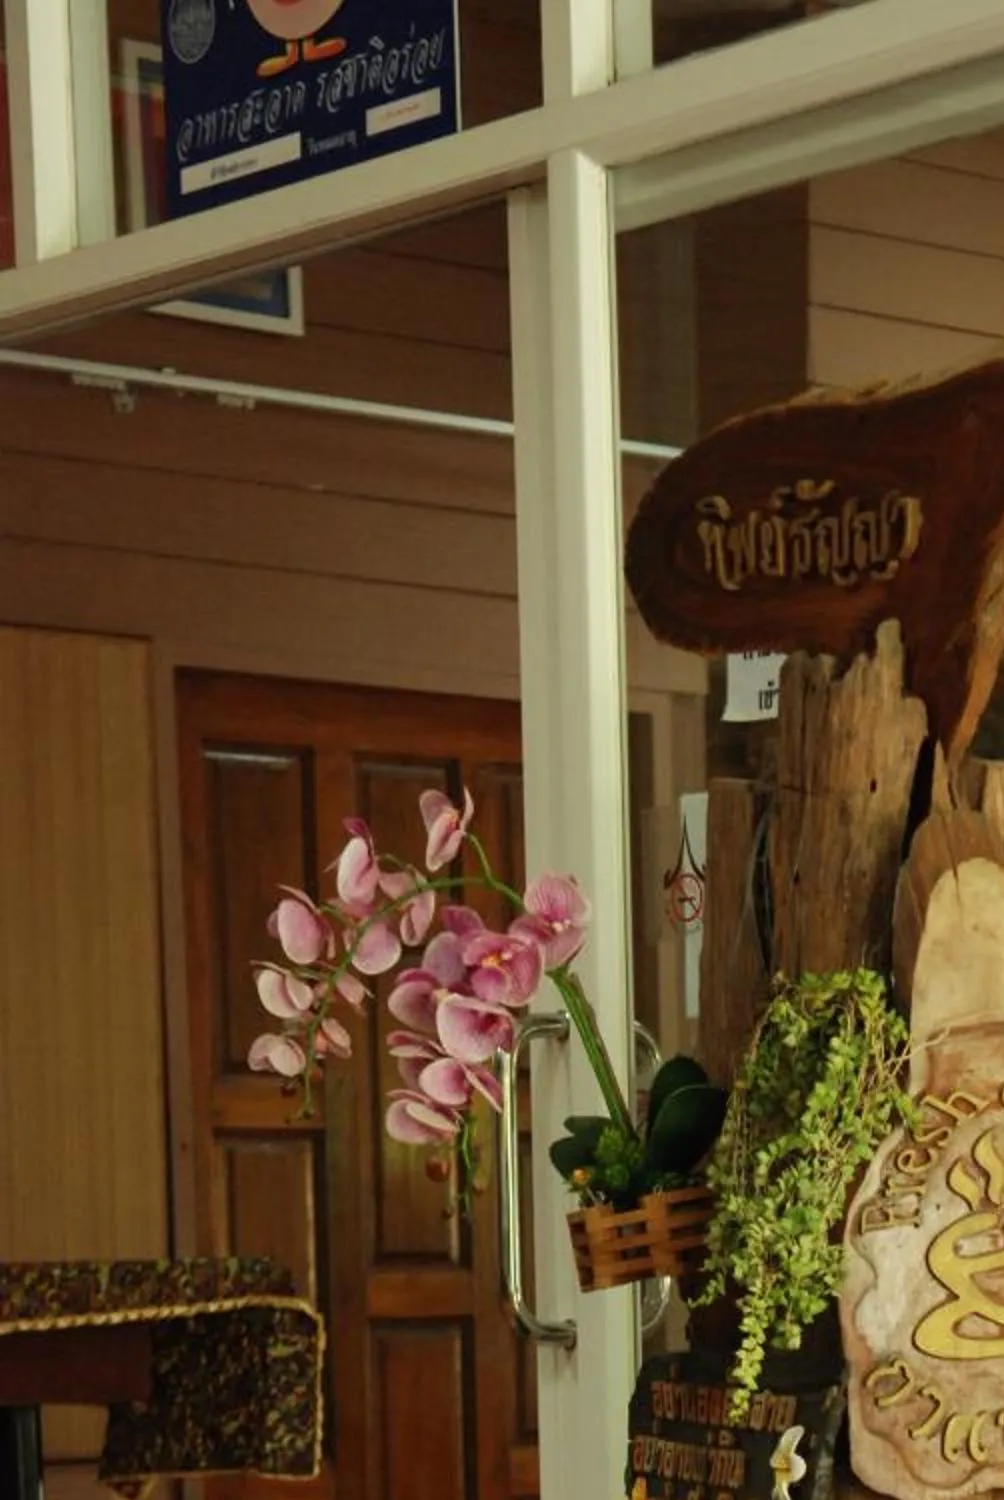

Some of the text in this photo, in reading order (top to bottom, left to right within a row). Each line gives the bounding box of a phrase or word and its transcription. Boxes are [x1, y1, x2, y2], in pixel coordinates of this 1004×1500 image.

[176, 24, 447, 162] อาหารสะอาด รสชาติอร่อย
[861, 1091, 989, 1235] Fresh
